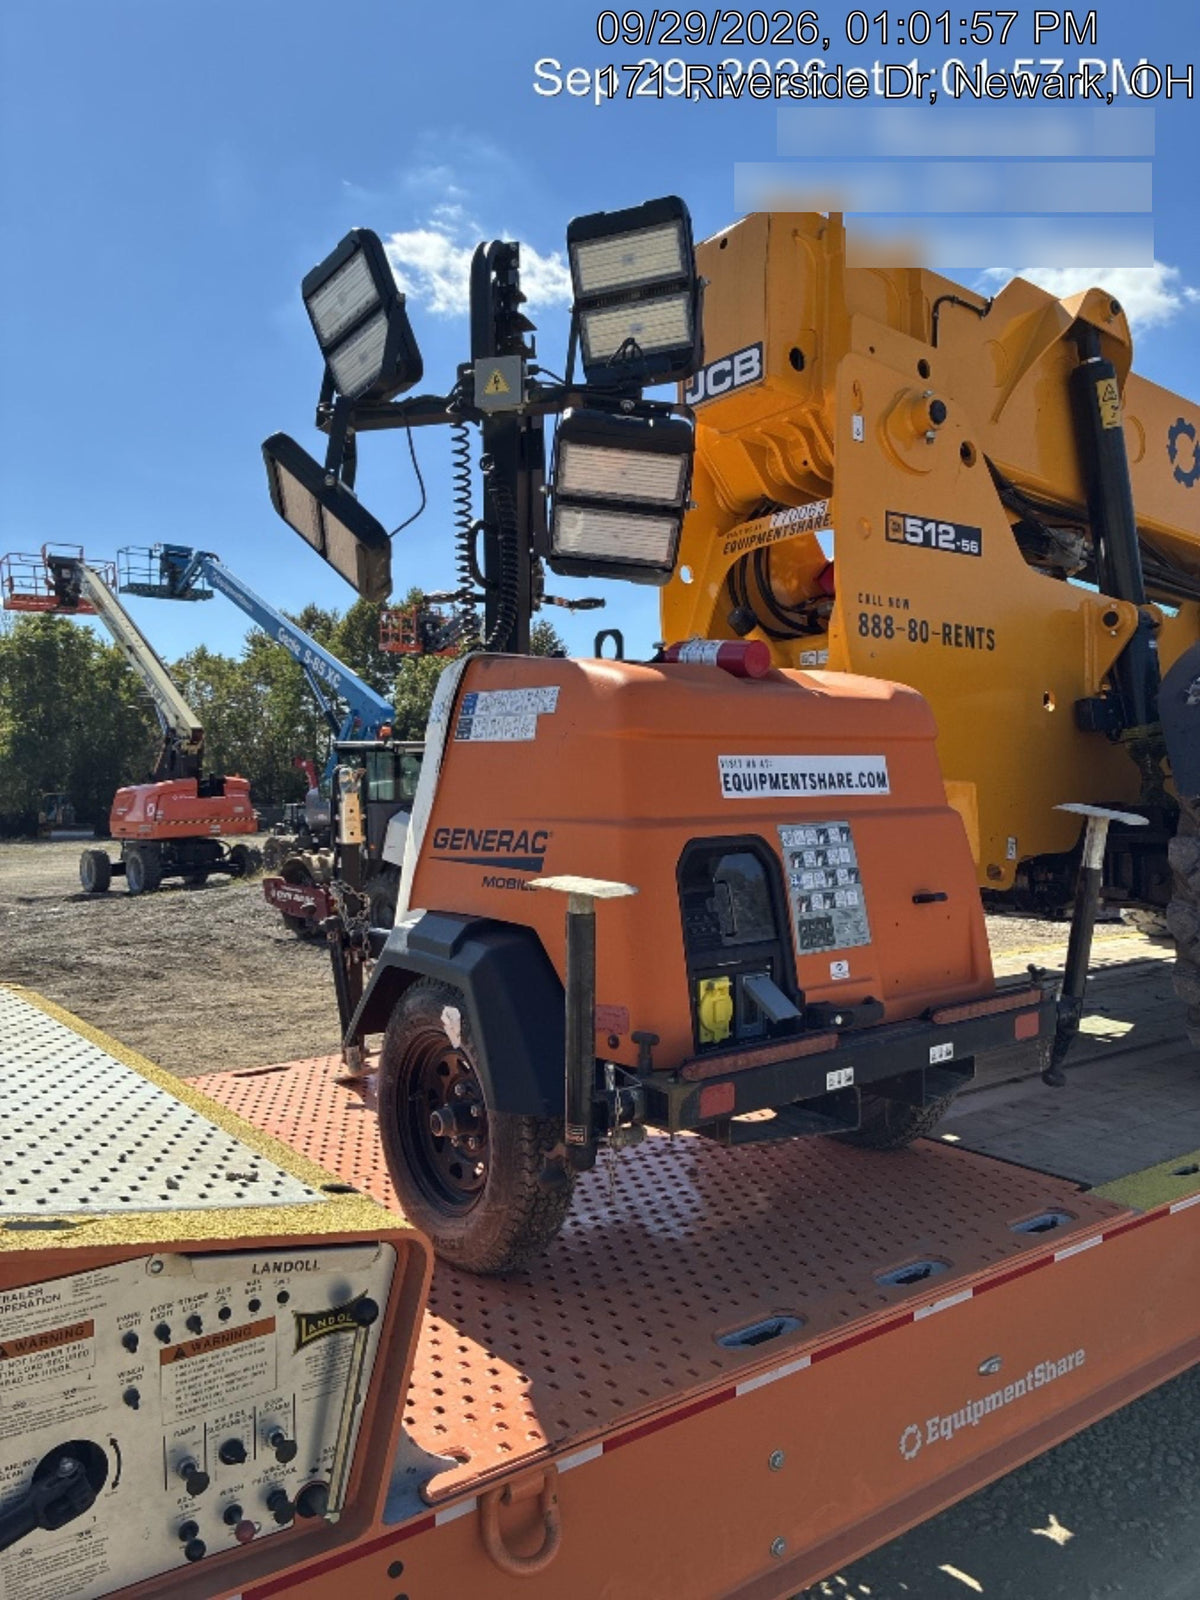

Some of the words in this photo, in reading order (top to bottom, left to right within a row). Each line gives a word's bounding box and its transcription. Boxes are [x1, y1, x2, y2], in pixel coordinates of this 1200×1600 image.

[686, 348, 760, 404] JCB
[858, 592, 883, 607] CALL
[858, 612, 995, 651] 888-80-RENTS
[722, 770, 888, 793] EQUIPMENTSHARE.COM
[433, 828, 548, 853] GENERAC
[482, 876, 537, 891] MOBIL
[252, 1259, 320, 1275] LANDOLL
[15, 1325, 85, 1352] WARNING
[191, 1327, 253, 1352] WARNING
[302, 1312, 355, 1342] LANDOL
[926, 1348, 1086, 1445] EquipmentShare
